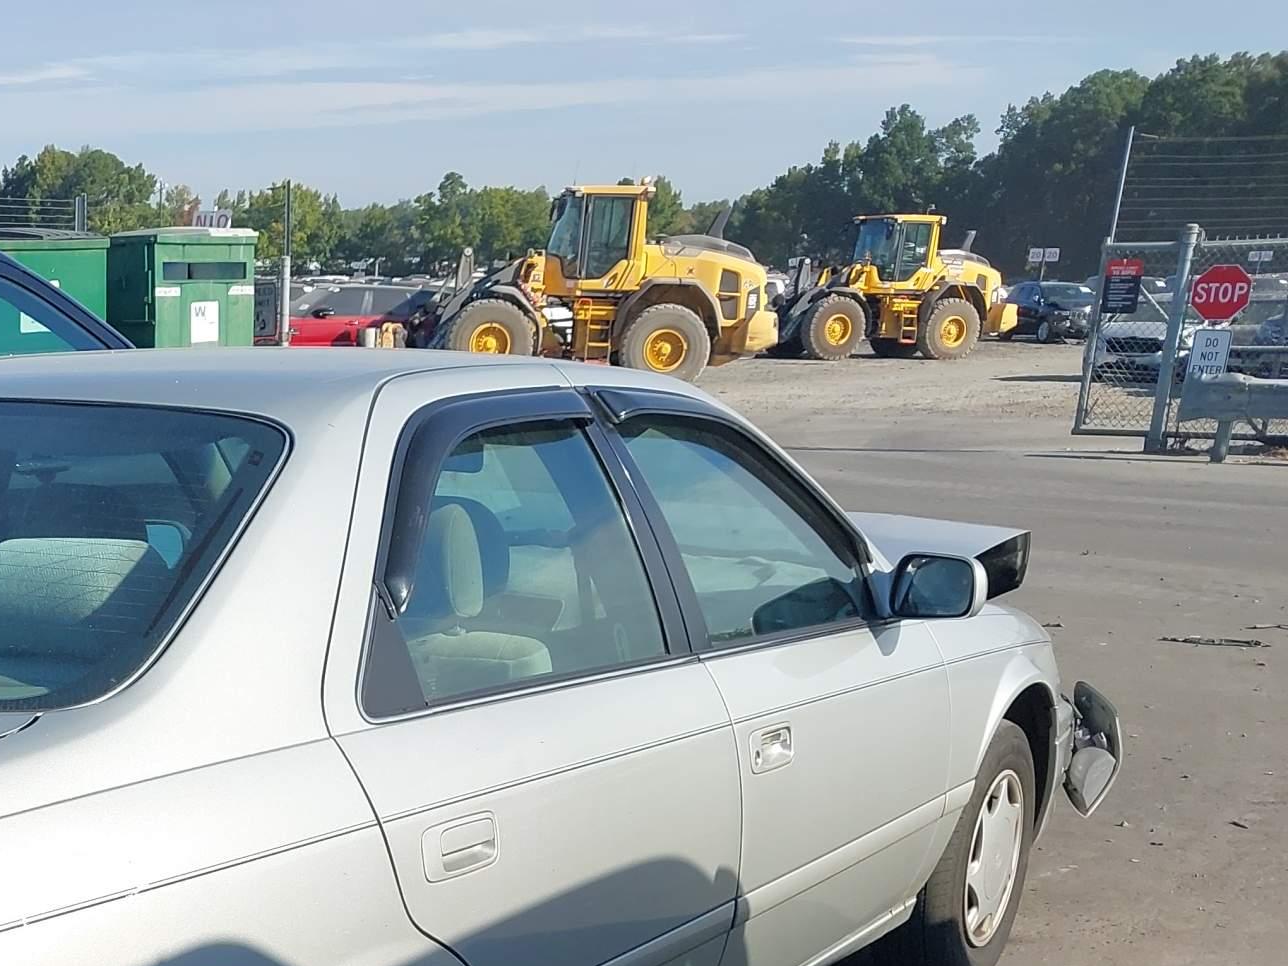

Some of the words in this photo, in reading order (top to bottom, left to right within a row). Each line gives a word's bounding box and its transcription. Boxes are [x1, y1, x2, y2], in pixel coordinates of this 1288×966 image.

[1194, 282, 1249, 303] STOP
[1205, 337, 1219, 348] DO
[1199, 351, 1220, 361] NOT
[1192, 364, 1223, 375] ENTER
